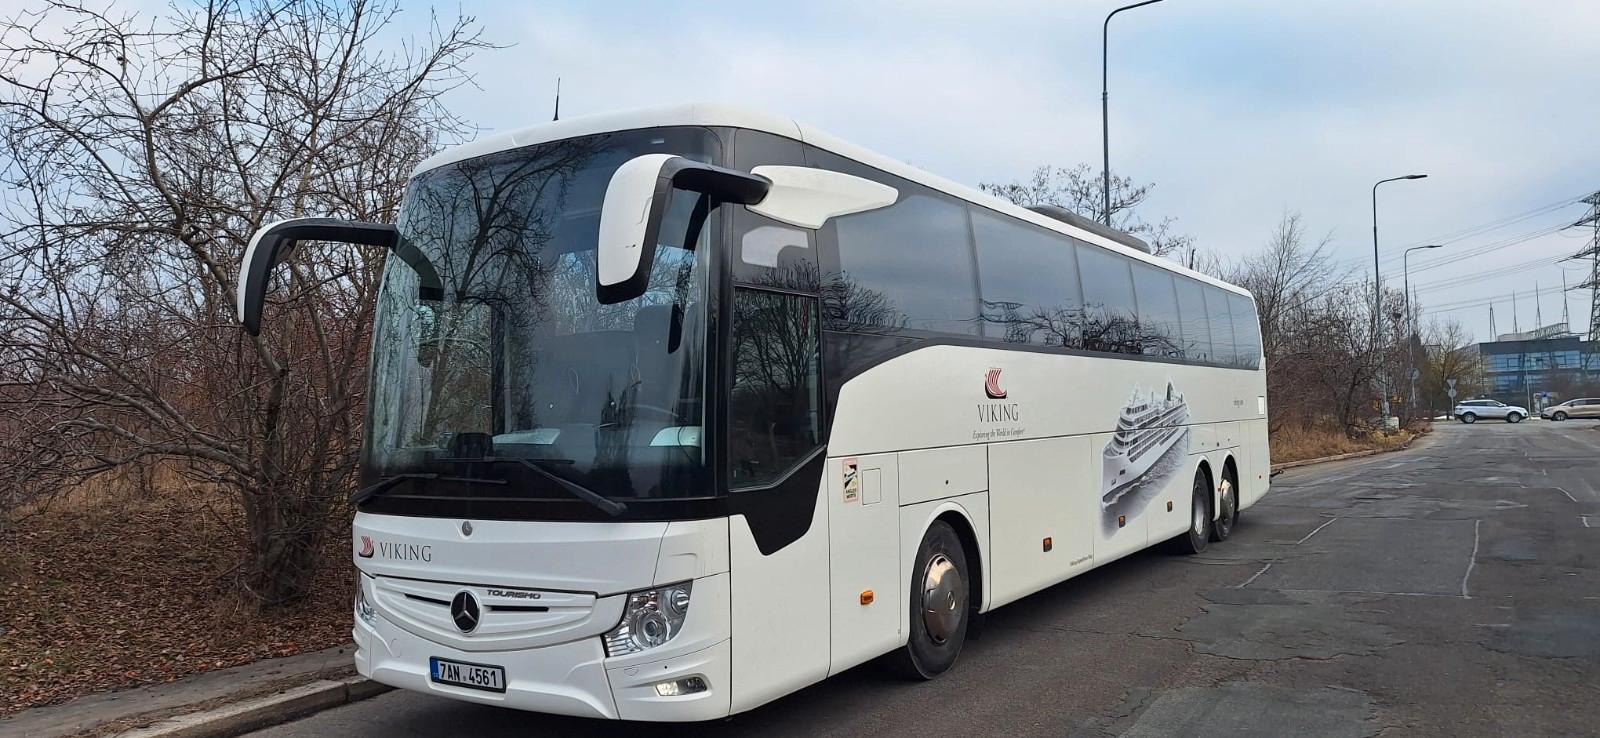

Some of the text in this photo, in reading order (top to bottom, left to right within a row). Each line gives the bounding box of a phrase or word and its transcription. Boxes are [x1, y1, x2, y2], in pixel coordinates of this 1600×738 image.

[977, 403, 1018, 422] VIKING
[380, 542, 431, 562] VIKING
[487, 589, 541, 600] TOURISMO
[440, 663, 497, 687] 7AN 4561
